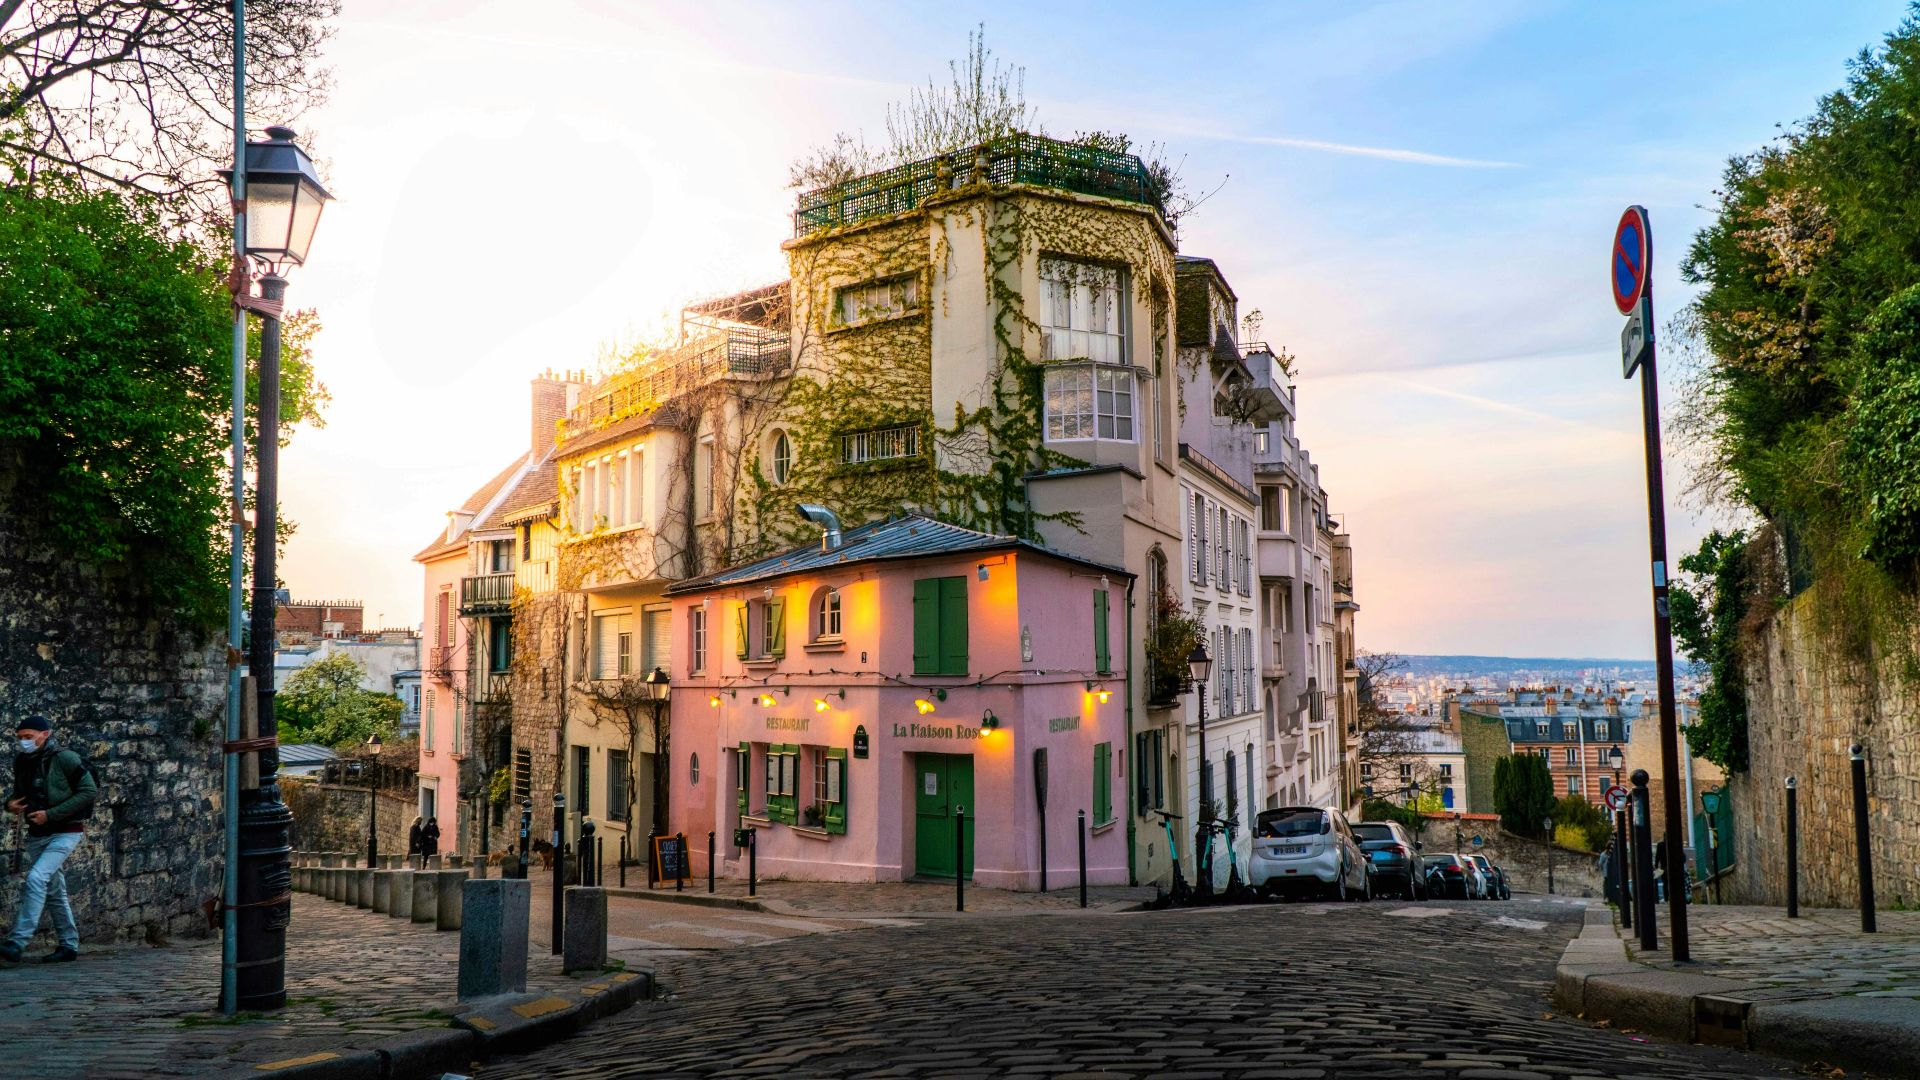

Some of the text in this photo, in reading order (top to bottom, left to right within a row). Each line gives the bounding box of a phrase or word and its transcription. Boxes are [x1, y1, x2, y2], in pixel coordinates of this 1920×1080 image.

[766, 717, 810, 732] RESTAURANT
[893, 723, 907, 738] La
[910, 723, 953, 739] Maison
[1048, 715, 1081, 734] RESTAURANT
